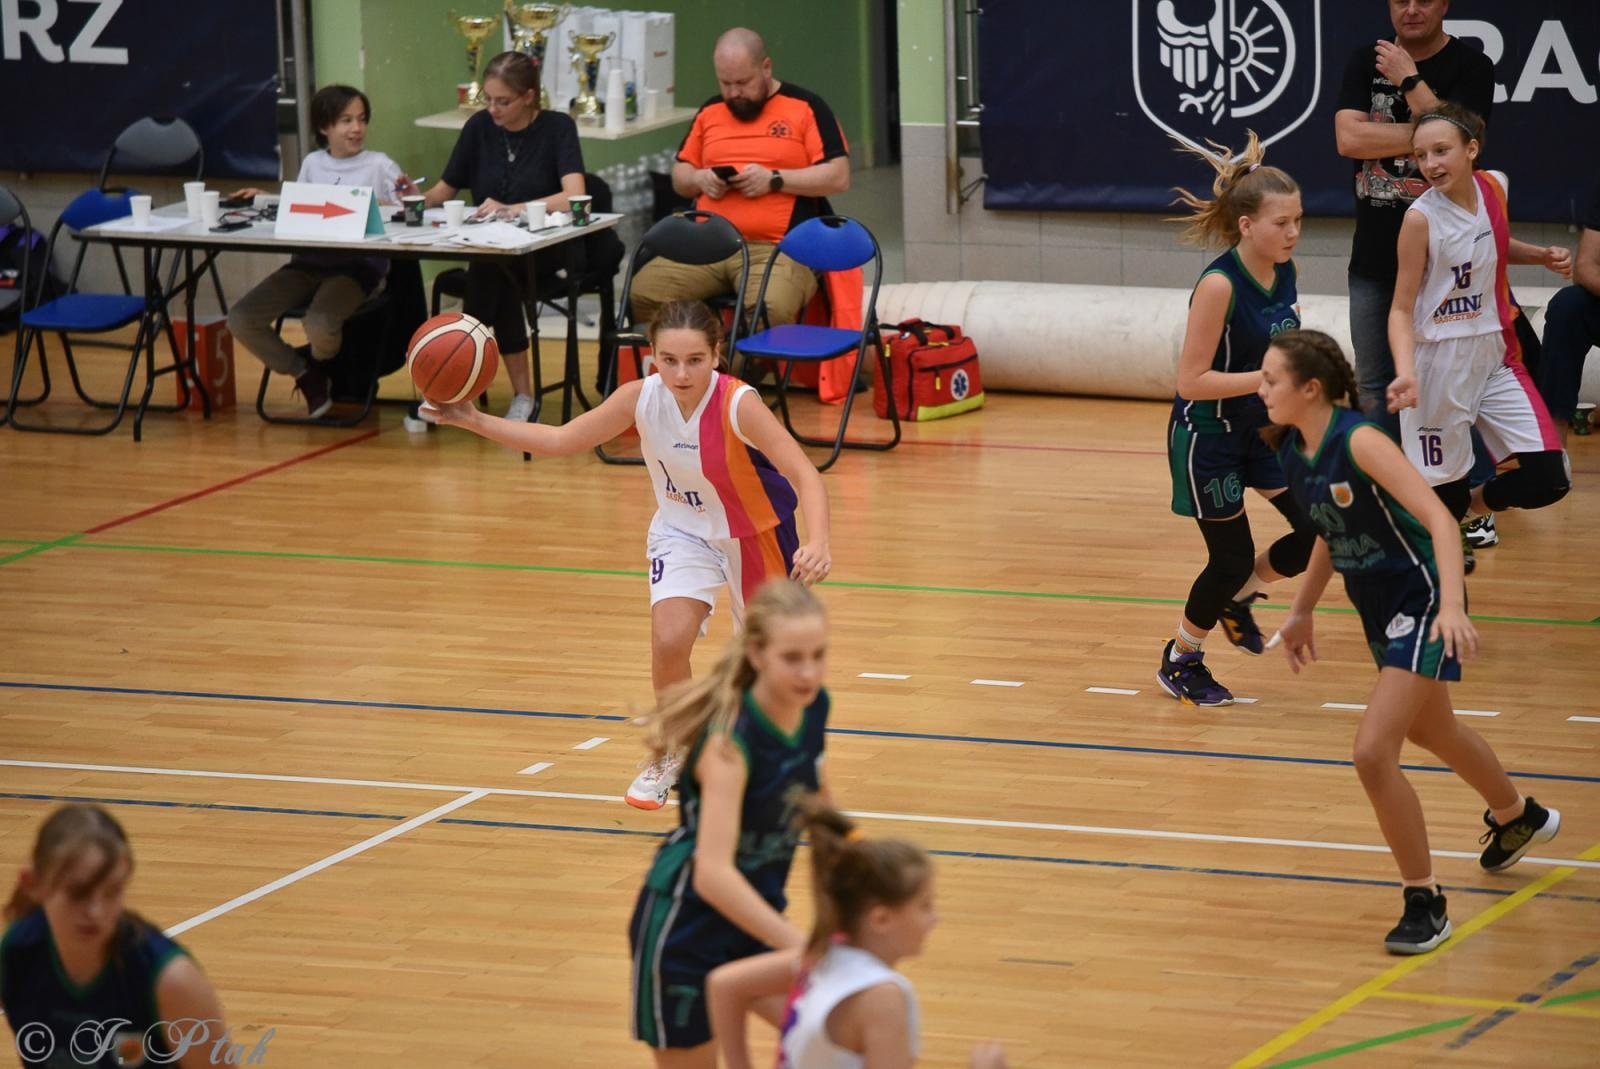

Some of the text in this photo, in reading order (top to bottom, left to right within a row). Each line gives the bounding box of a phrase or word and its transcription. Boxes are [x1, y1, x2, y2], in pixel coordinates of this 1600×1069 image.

[1442, 19, 1600, 104] RA
[1419, 435, 1443, 466] 16
[1203, 472, 1241, 508] 16
